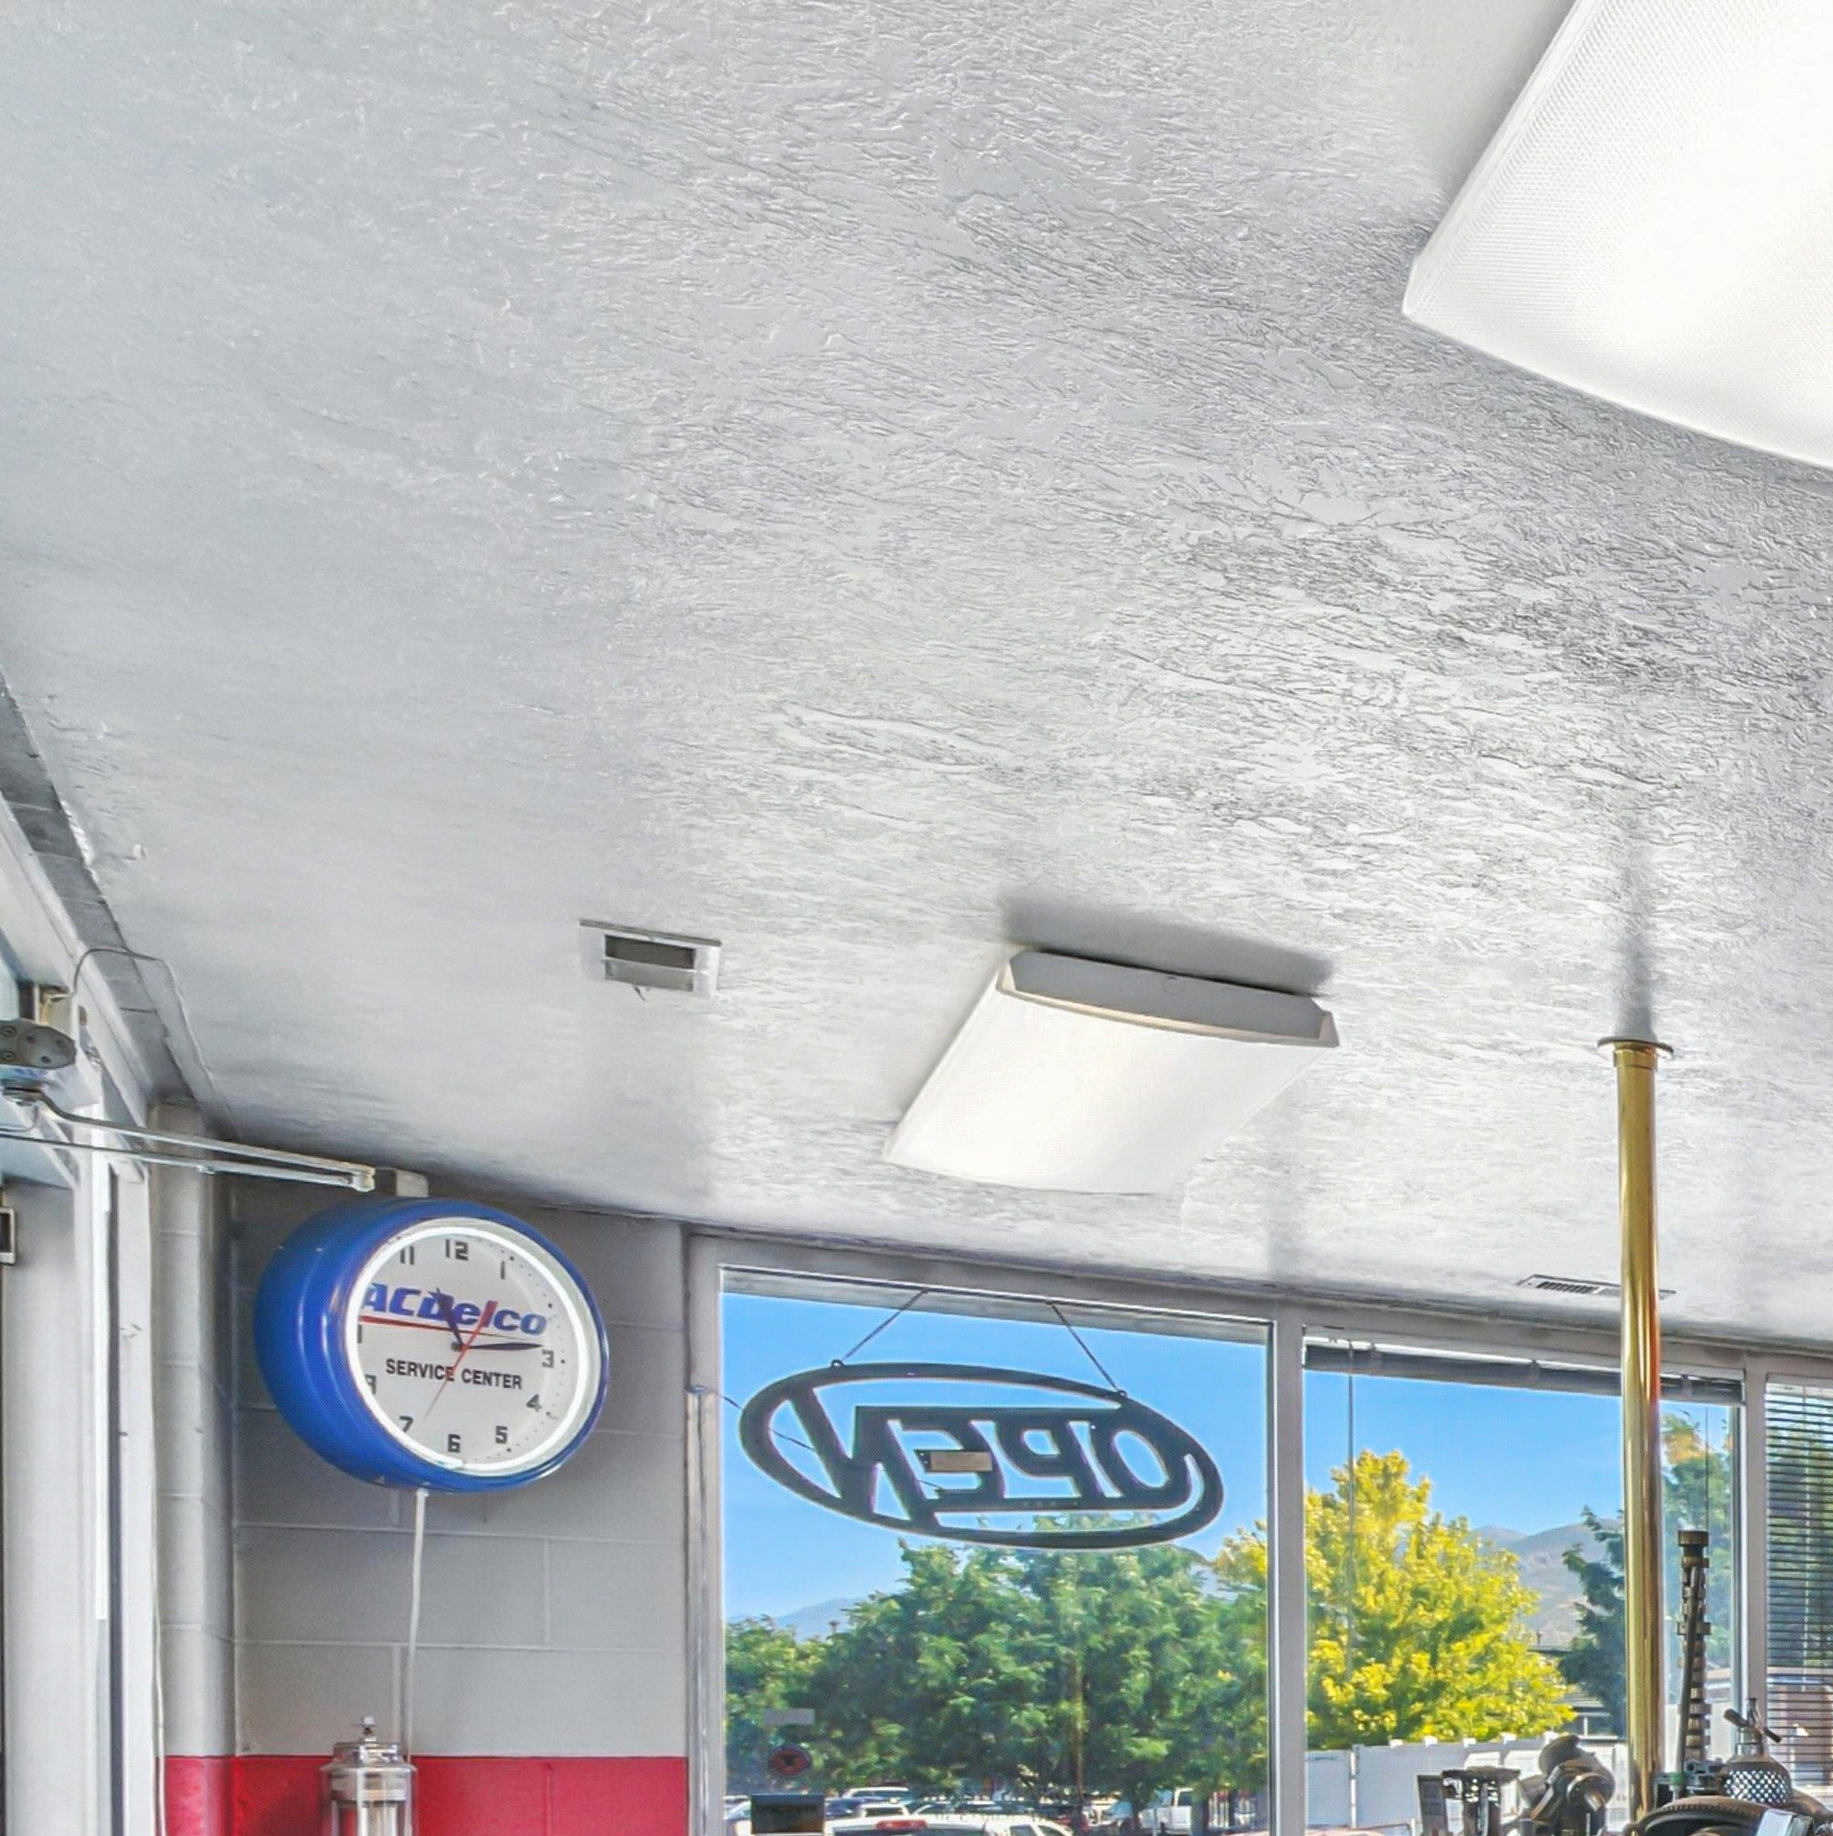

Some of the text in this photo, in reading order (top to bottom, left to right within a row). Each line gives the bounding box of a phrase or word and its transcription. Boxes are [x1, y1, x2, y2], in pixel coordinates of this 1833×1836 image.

[445, 1239, 469, 1261] 12
[359, 1282, 548, 1336] ACDelco
[541, 1350, 554, 1368] 3
[385, 1358, 523, 1390] SERVICE CENTER
[526, 1394, 541, 1412] 4
[399, 1416, 414, 1433] 7
[448, 1434, 461, 1453] 6
[495, 1425, 508, 1445] 5
